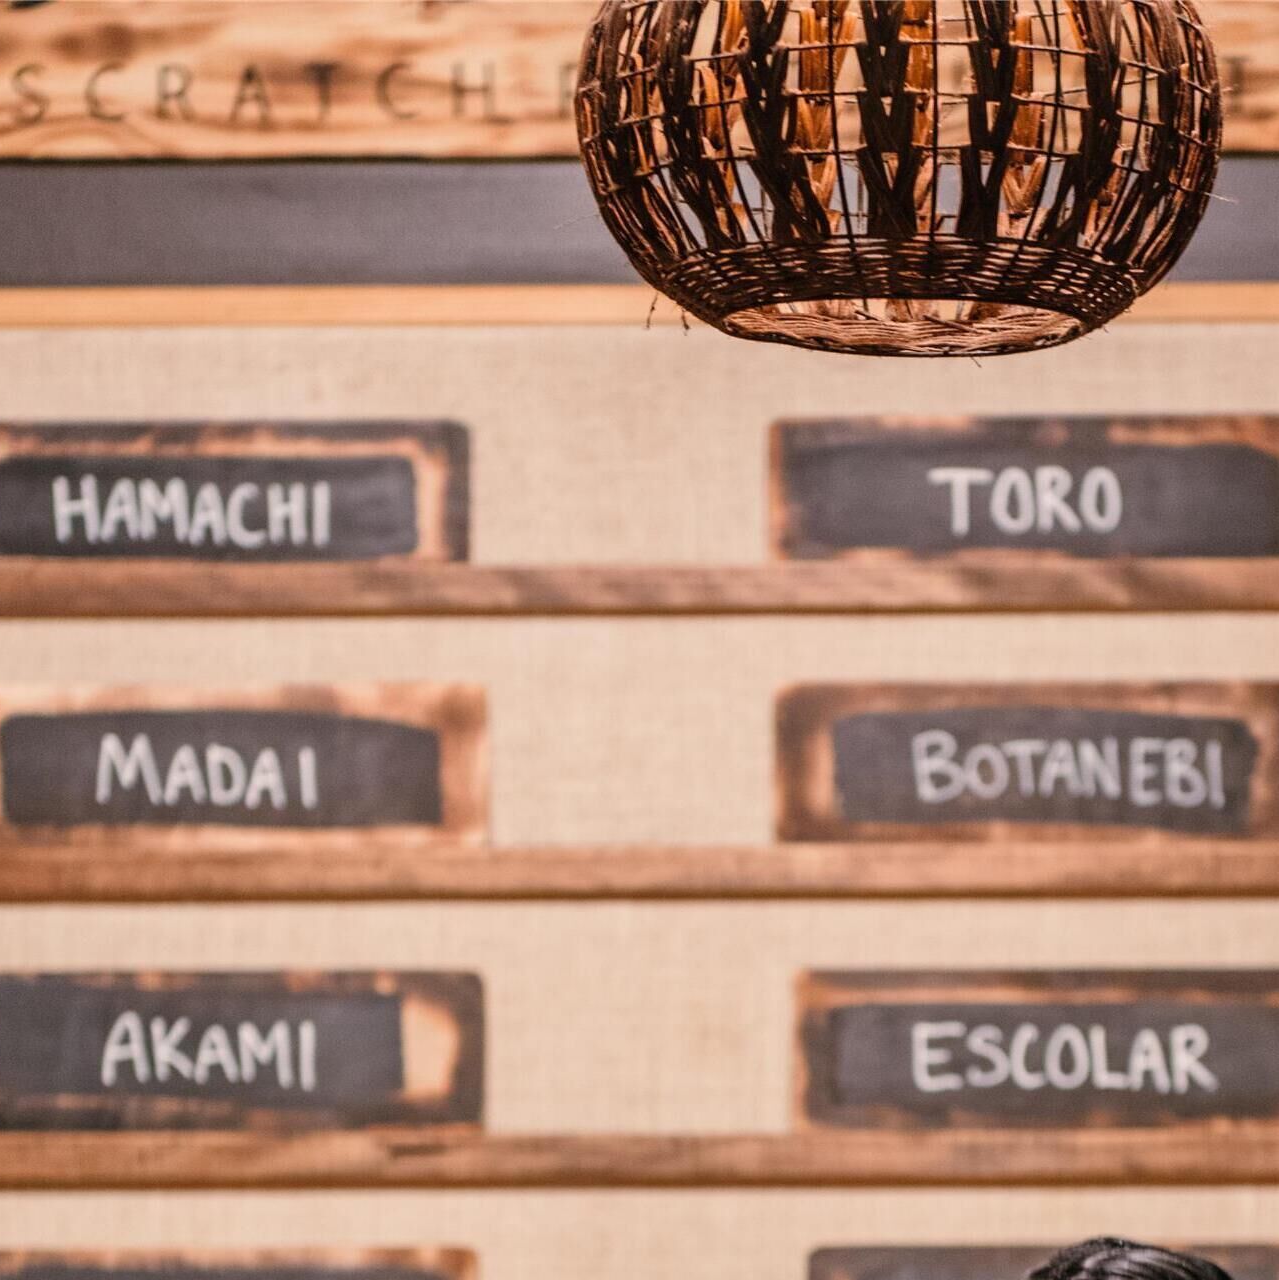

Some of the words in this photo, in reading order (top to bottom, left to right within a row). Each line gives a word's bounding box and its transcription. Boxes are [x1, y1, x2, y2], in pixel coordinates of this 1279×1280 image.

[10, 60, 515, 124] SCRATCH
[52, 474, 329, 547] HAMACHI
[926, 466, 1122, 536] TORO
[94, 732, 318, 810] MADAI
[100, 1010, 319, 1092] AKAMI
[911, 1021, 1219, 1094] ESCOLAR
